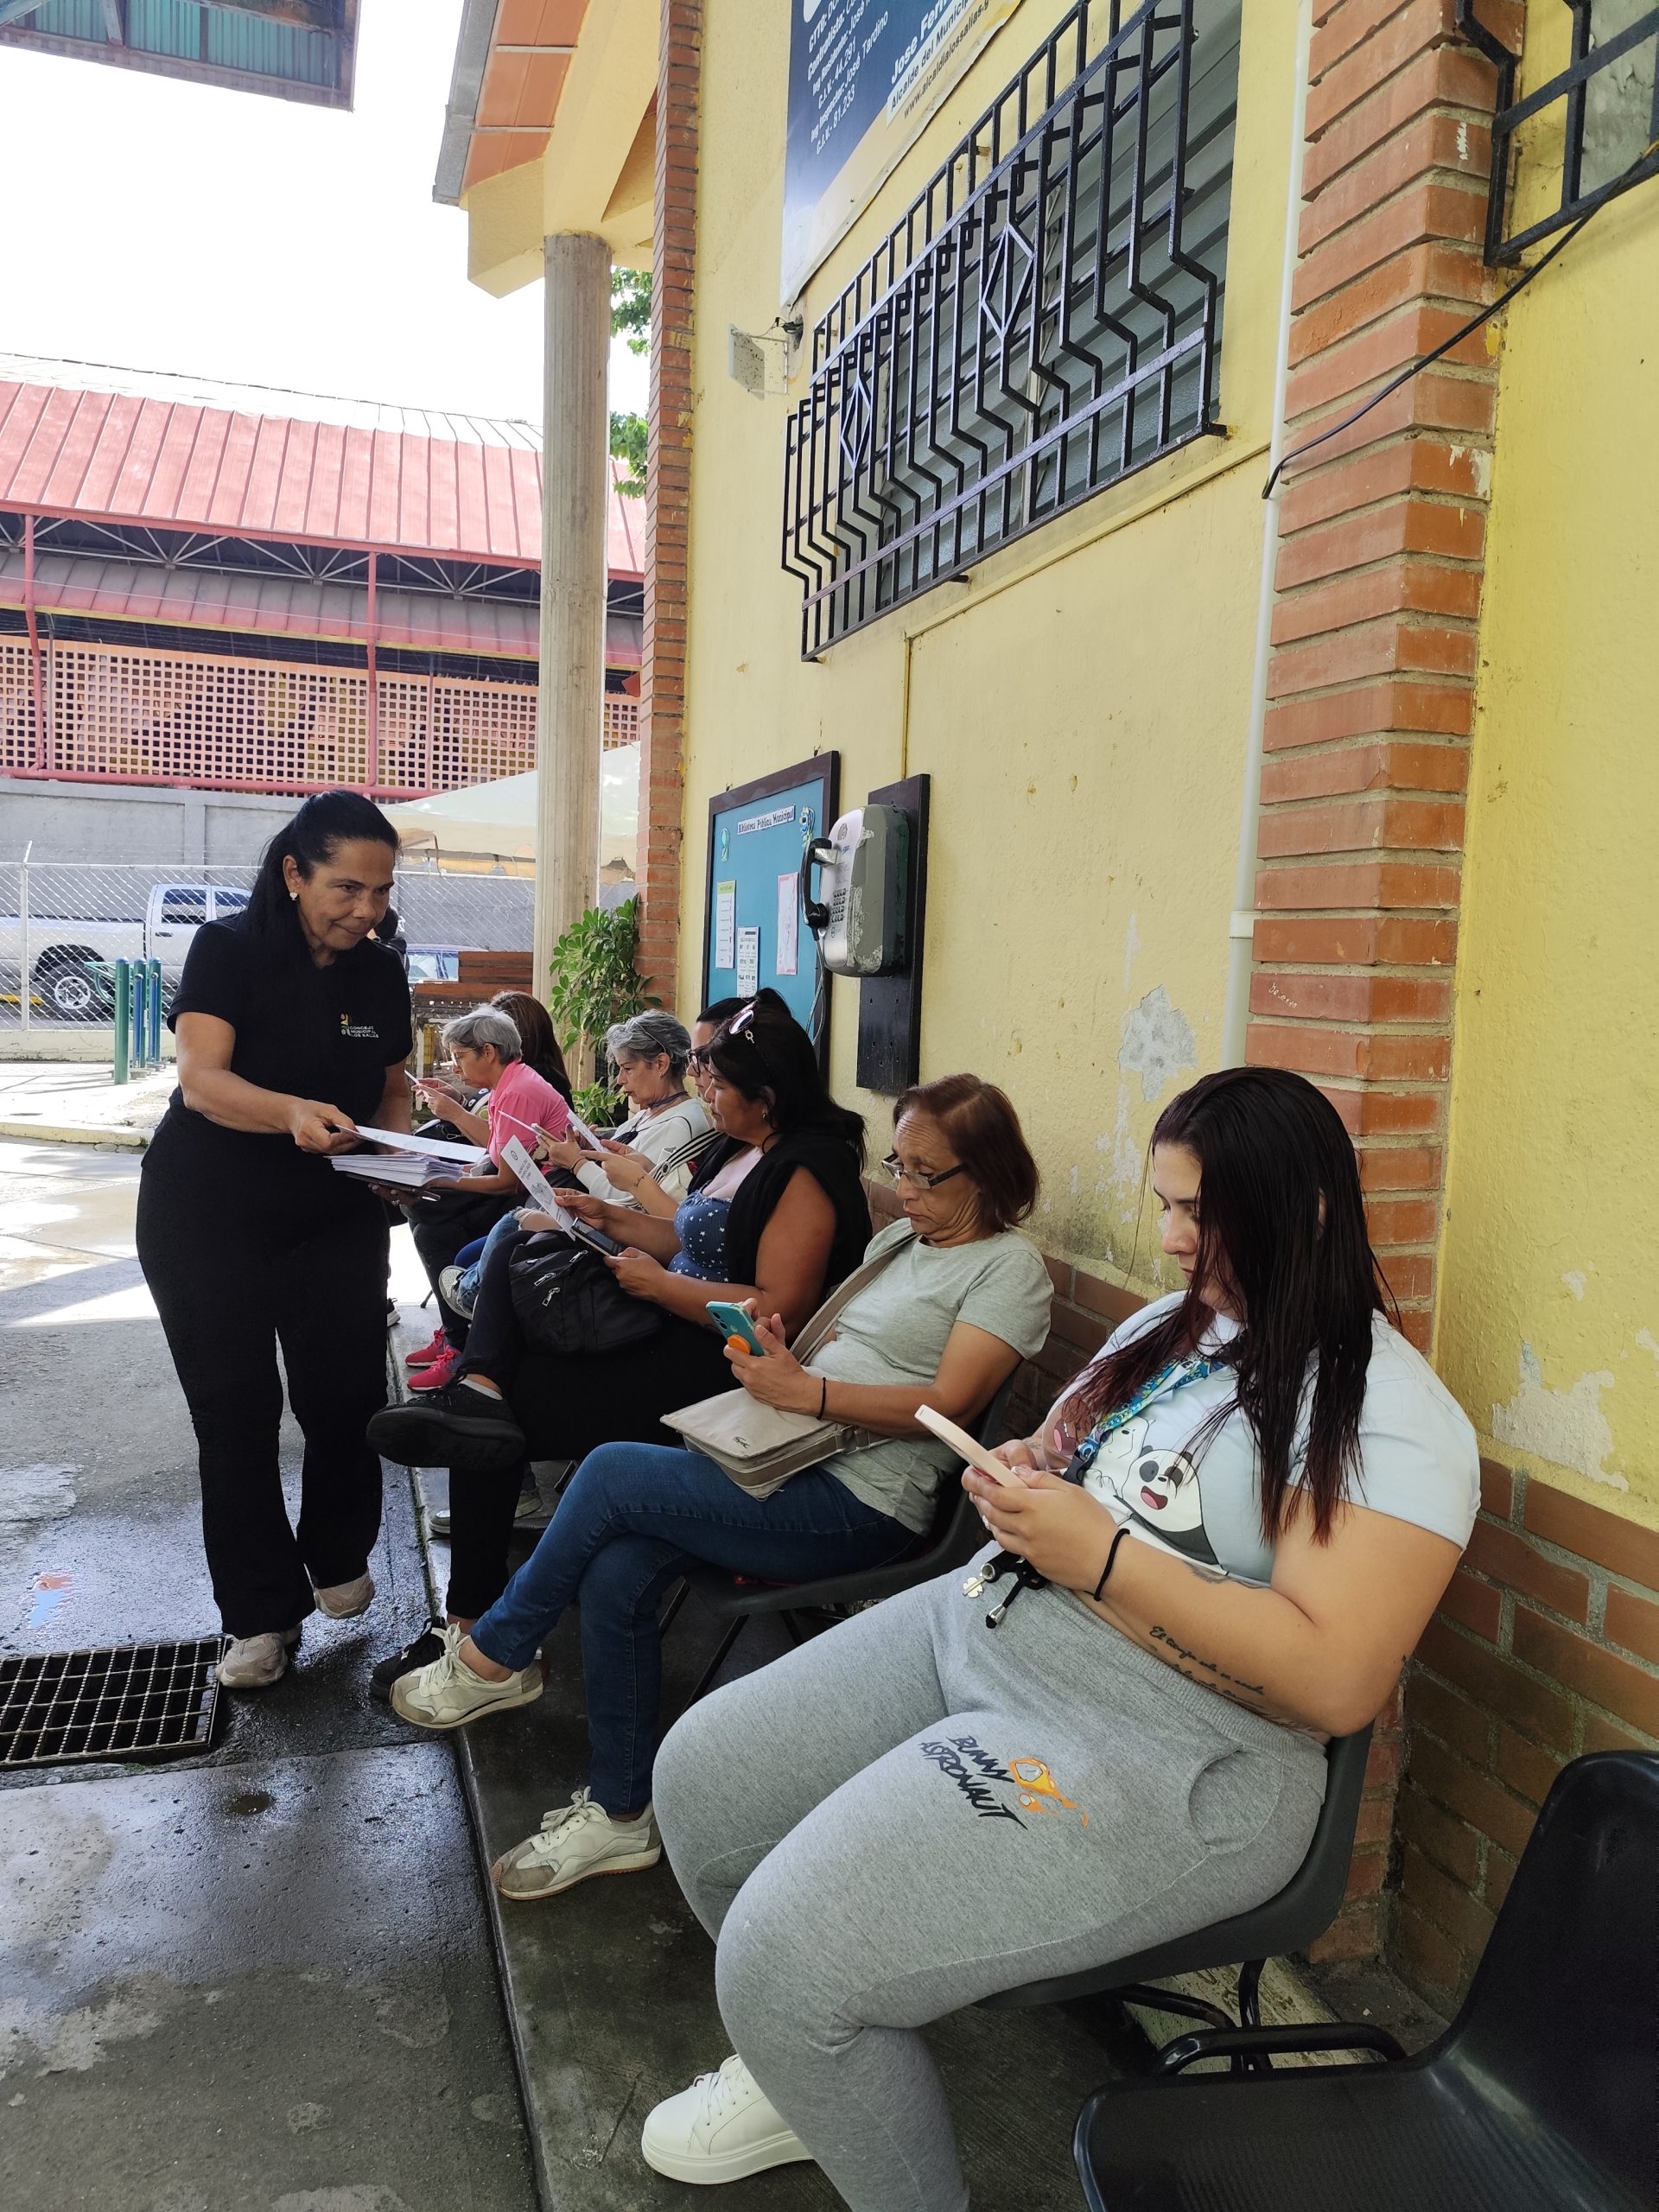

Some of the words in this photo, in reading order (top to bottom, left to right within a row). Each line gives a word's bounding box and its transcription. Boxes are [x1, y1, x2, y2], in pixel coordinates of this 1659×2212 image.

[808, 9, 845, 81] Contratista:
[819, 82, 844, 129] Inspector:
[845, 52, 860, 88] José
[862, 10, 888, 60] Tardino
[822, 30, 849, 82] Residente:
[835, 35, 856, 79] 44.291
[891, 35, 918, 84] Jose
[891, 65, 919, 112] Alcalde
[921, 39, 934, 67] del
[834, 83, 855, 128] 81.233
[773, 808, 794, 823] Municipal
[918, 1741, 1028, 1830] ASTRONAUT
